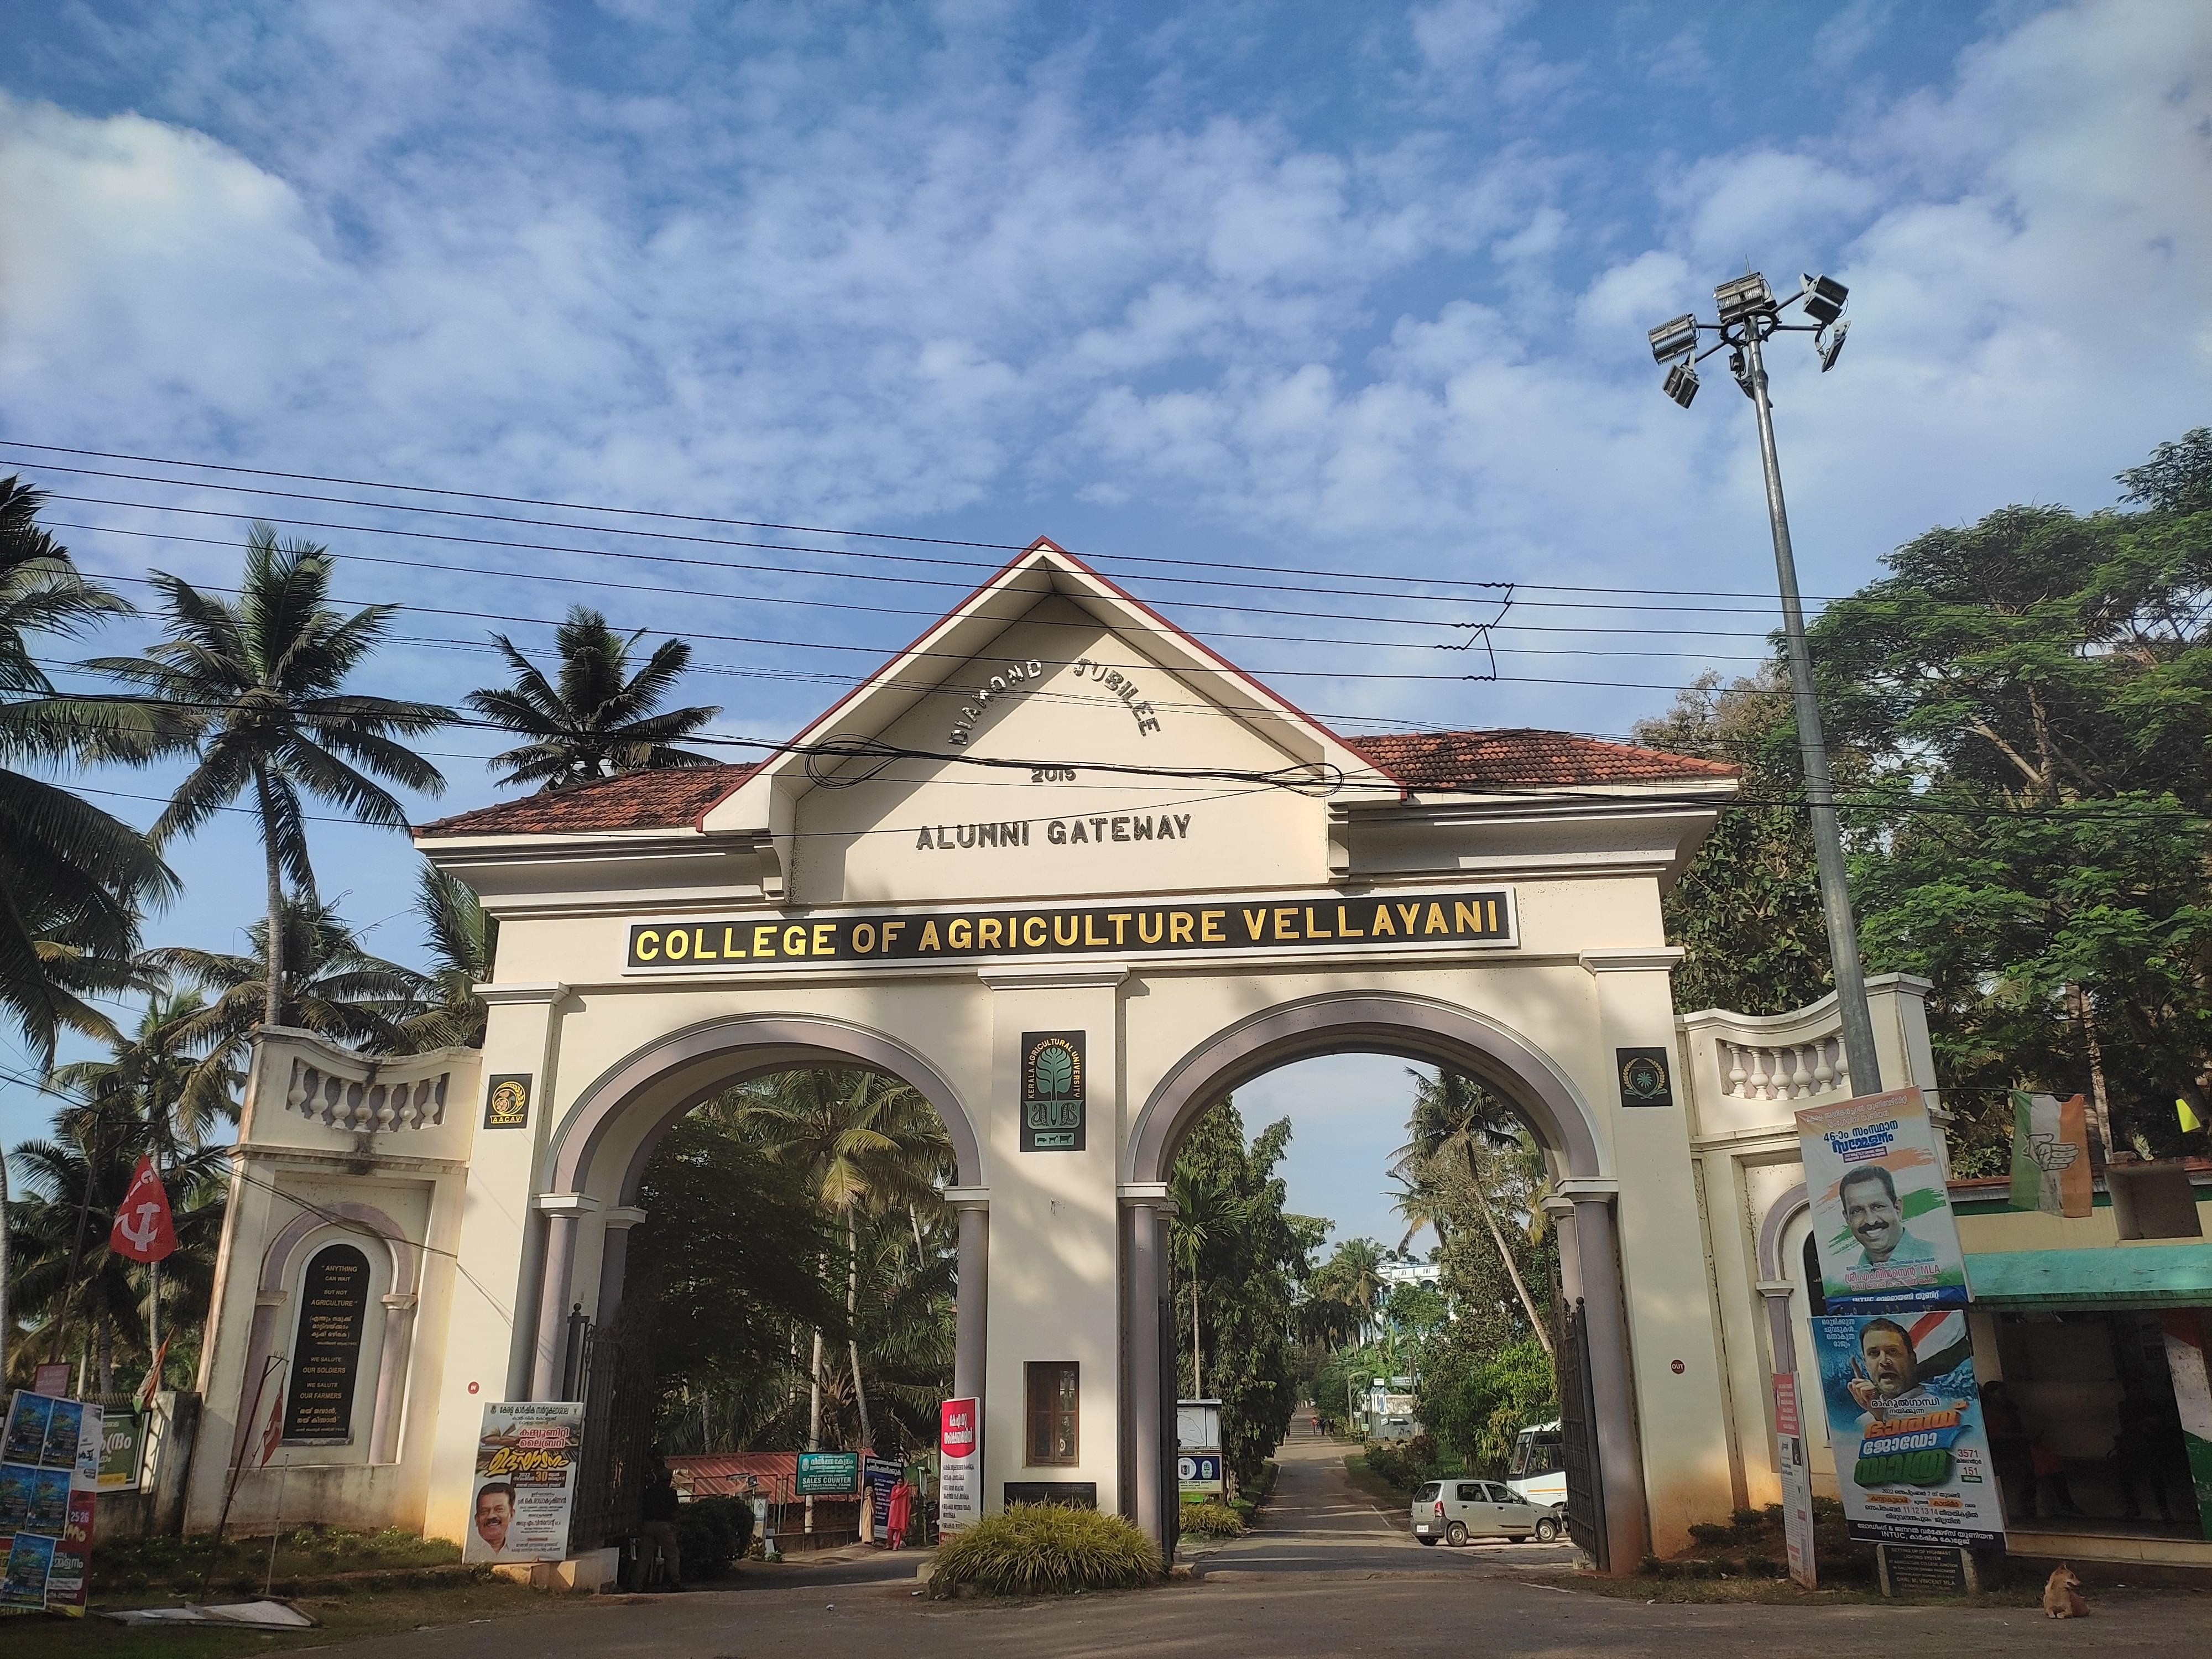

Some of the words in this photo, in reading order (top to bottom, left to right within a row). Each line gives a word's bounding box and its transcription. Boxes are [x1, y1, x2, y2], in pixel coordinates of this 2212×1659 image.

[947, 658, 1044, 745] DIAMOND
[1073, 656, 1161, 737] JUBILEE
[1031, 768, 1077, 783] 2015
[916, 821, 1030, 850] ALUMNI
[1047, 814, 1192, 845] GATEWAY
[636, 924, 836, 961] COLLEGE
[852, 921, 906, 953] OF
[917, 910, 1226, 951] AGRICULTURE
[1243, 900, 1497, 940] VELLAYANI
[1028, 1038, 1073, 1066] AGRICULTURAL
[1071, 1051, 1081, 1098] UNIVERSITY
[1853, 1120, 1898, 1137] സംസ്ഥാന
[1832, 1132, 1893, 1154] സമ്മേളനം
[1921, 1265, 1941, 1275] MLA
[1872, 1397, 1940, 1407] രാഹുൽഗാന്ധി
[520, 1439, 565, 1448] ലൈബ്രറി
[1863, 1432, 1937, 1455] ജോഡോ
[1958, 1449, 1978, 1458] 3571
[1854, 1449, 1947, 1486] യാത്ര
[1964, 1467, 1978, 1475] 151
[535, 1472, 547, 1481] 30
[70, 1511, 79, 1522] 25
[81, 1511, 88, 1522] 26
